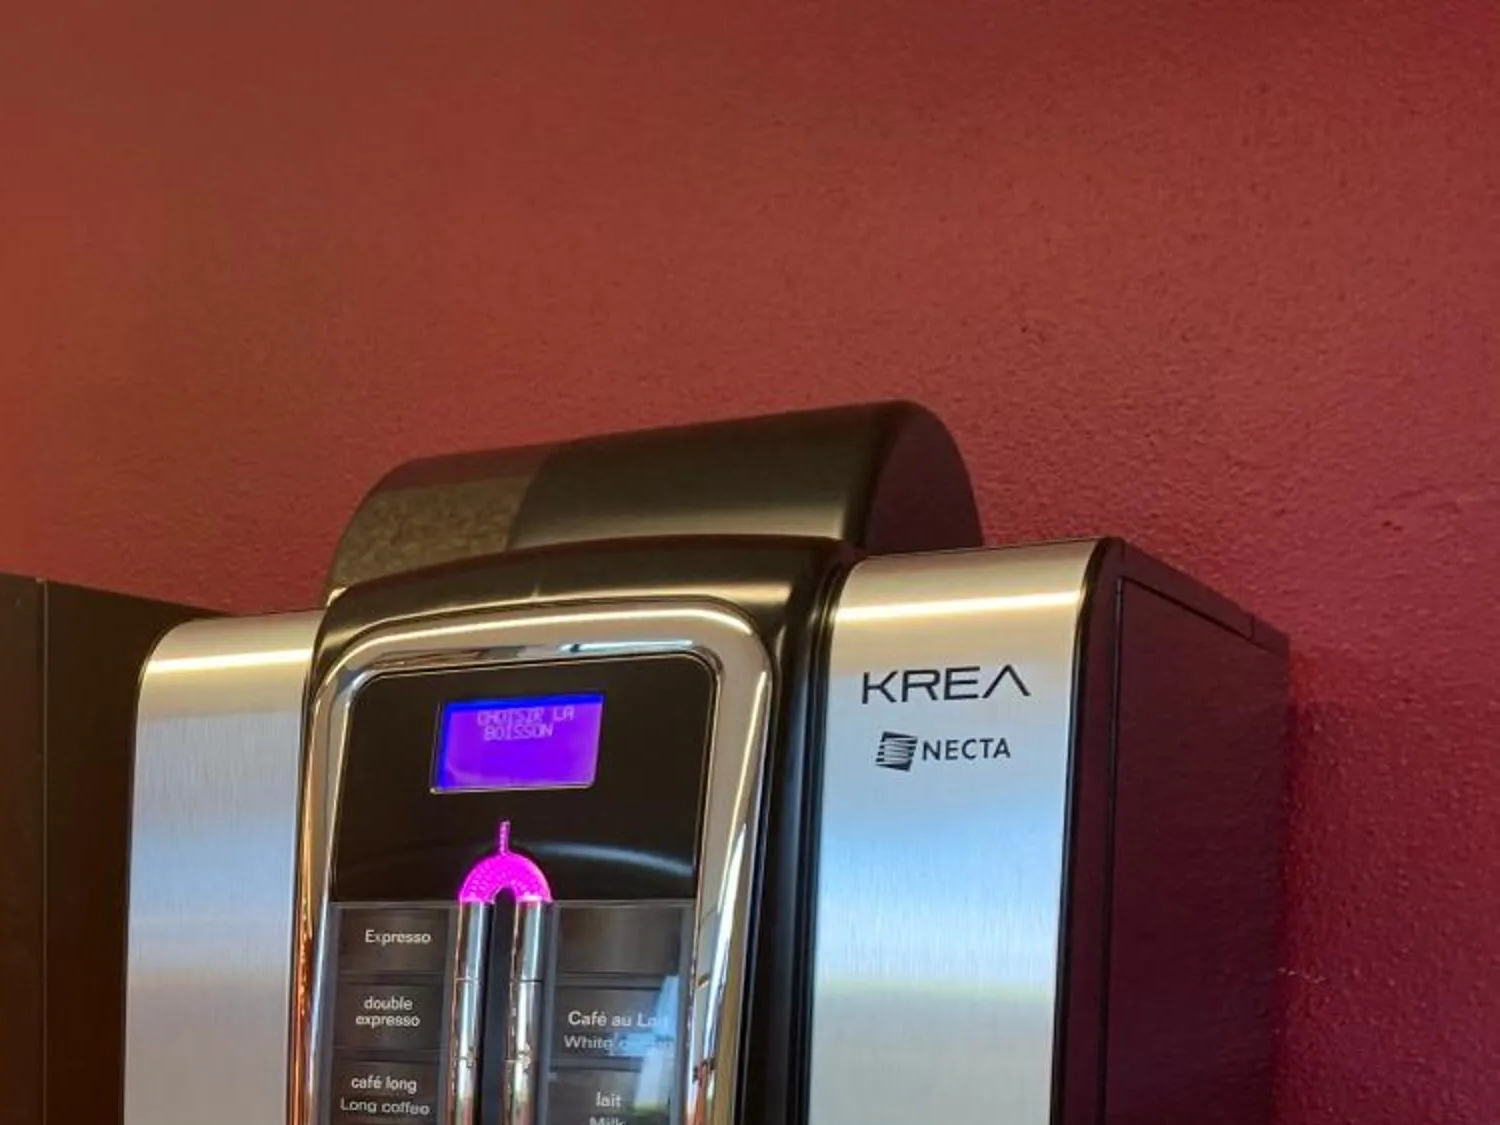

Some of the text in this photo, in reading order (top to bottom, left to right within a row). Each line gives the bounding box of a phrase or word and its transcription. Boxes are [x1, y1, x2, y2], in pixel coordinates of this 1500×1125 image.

[862, 664, 1031, 704] KREA
[553, 705, 575, 722] LA
[922, 737, 1011, 761] NECTA
[365, 930, 431, 945] Expresso
[364, 996, 414, 1011] double
[355, 1013, 421, 1028] expresso
[567, 1010, 608, 1027] Café
[611, 1014, 632, 1027] au
[351, 1075, 417, 1093] café long
[340, 1098, 377, 1114] Long
[595, 1091, 622, 1108] lait
